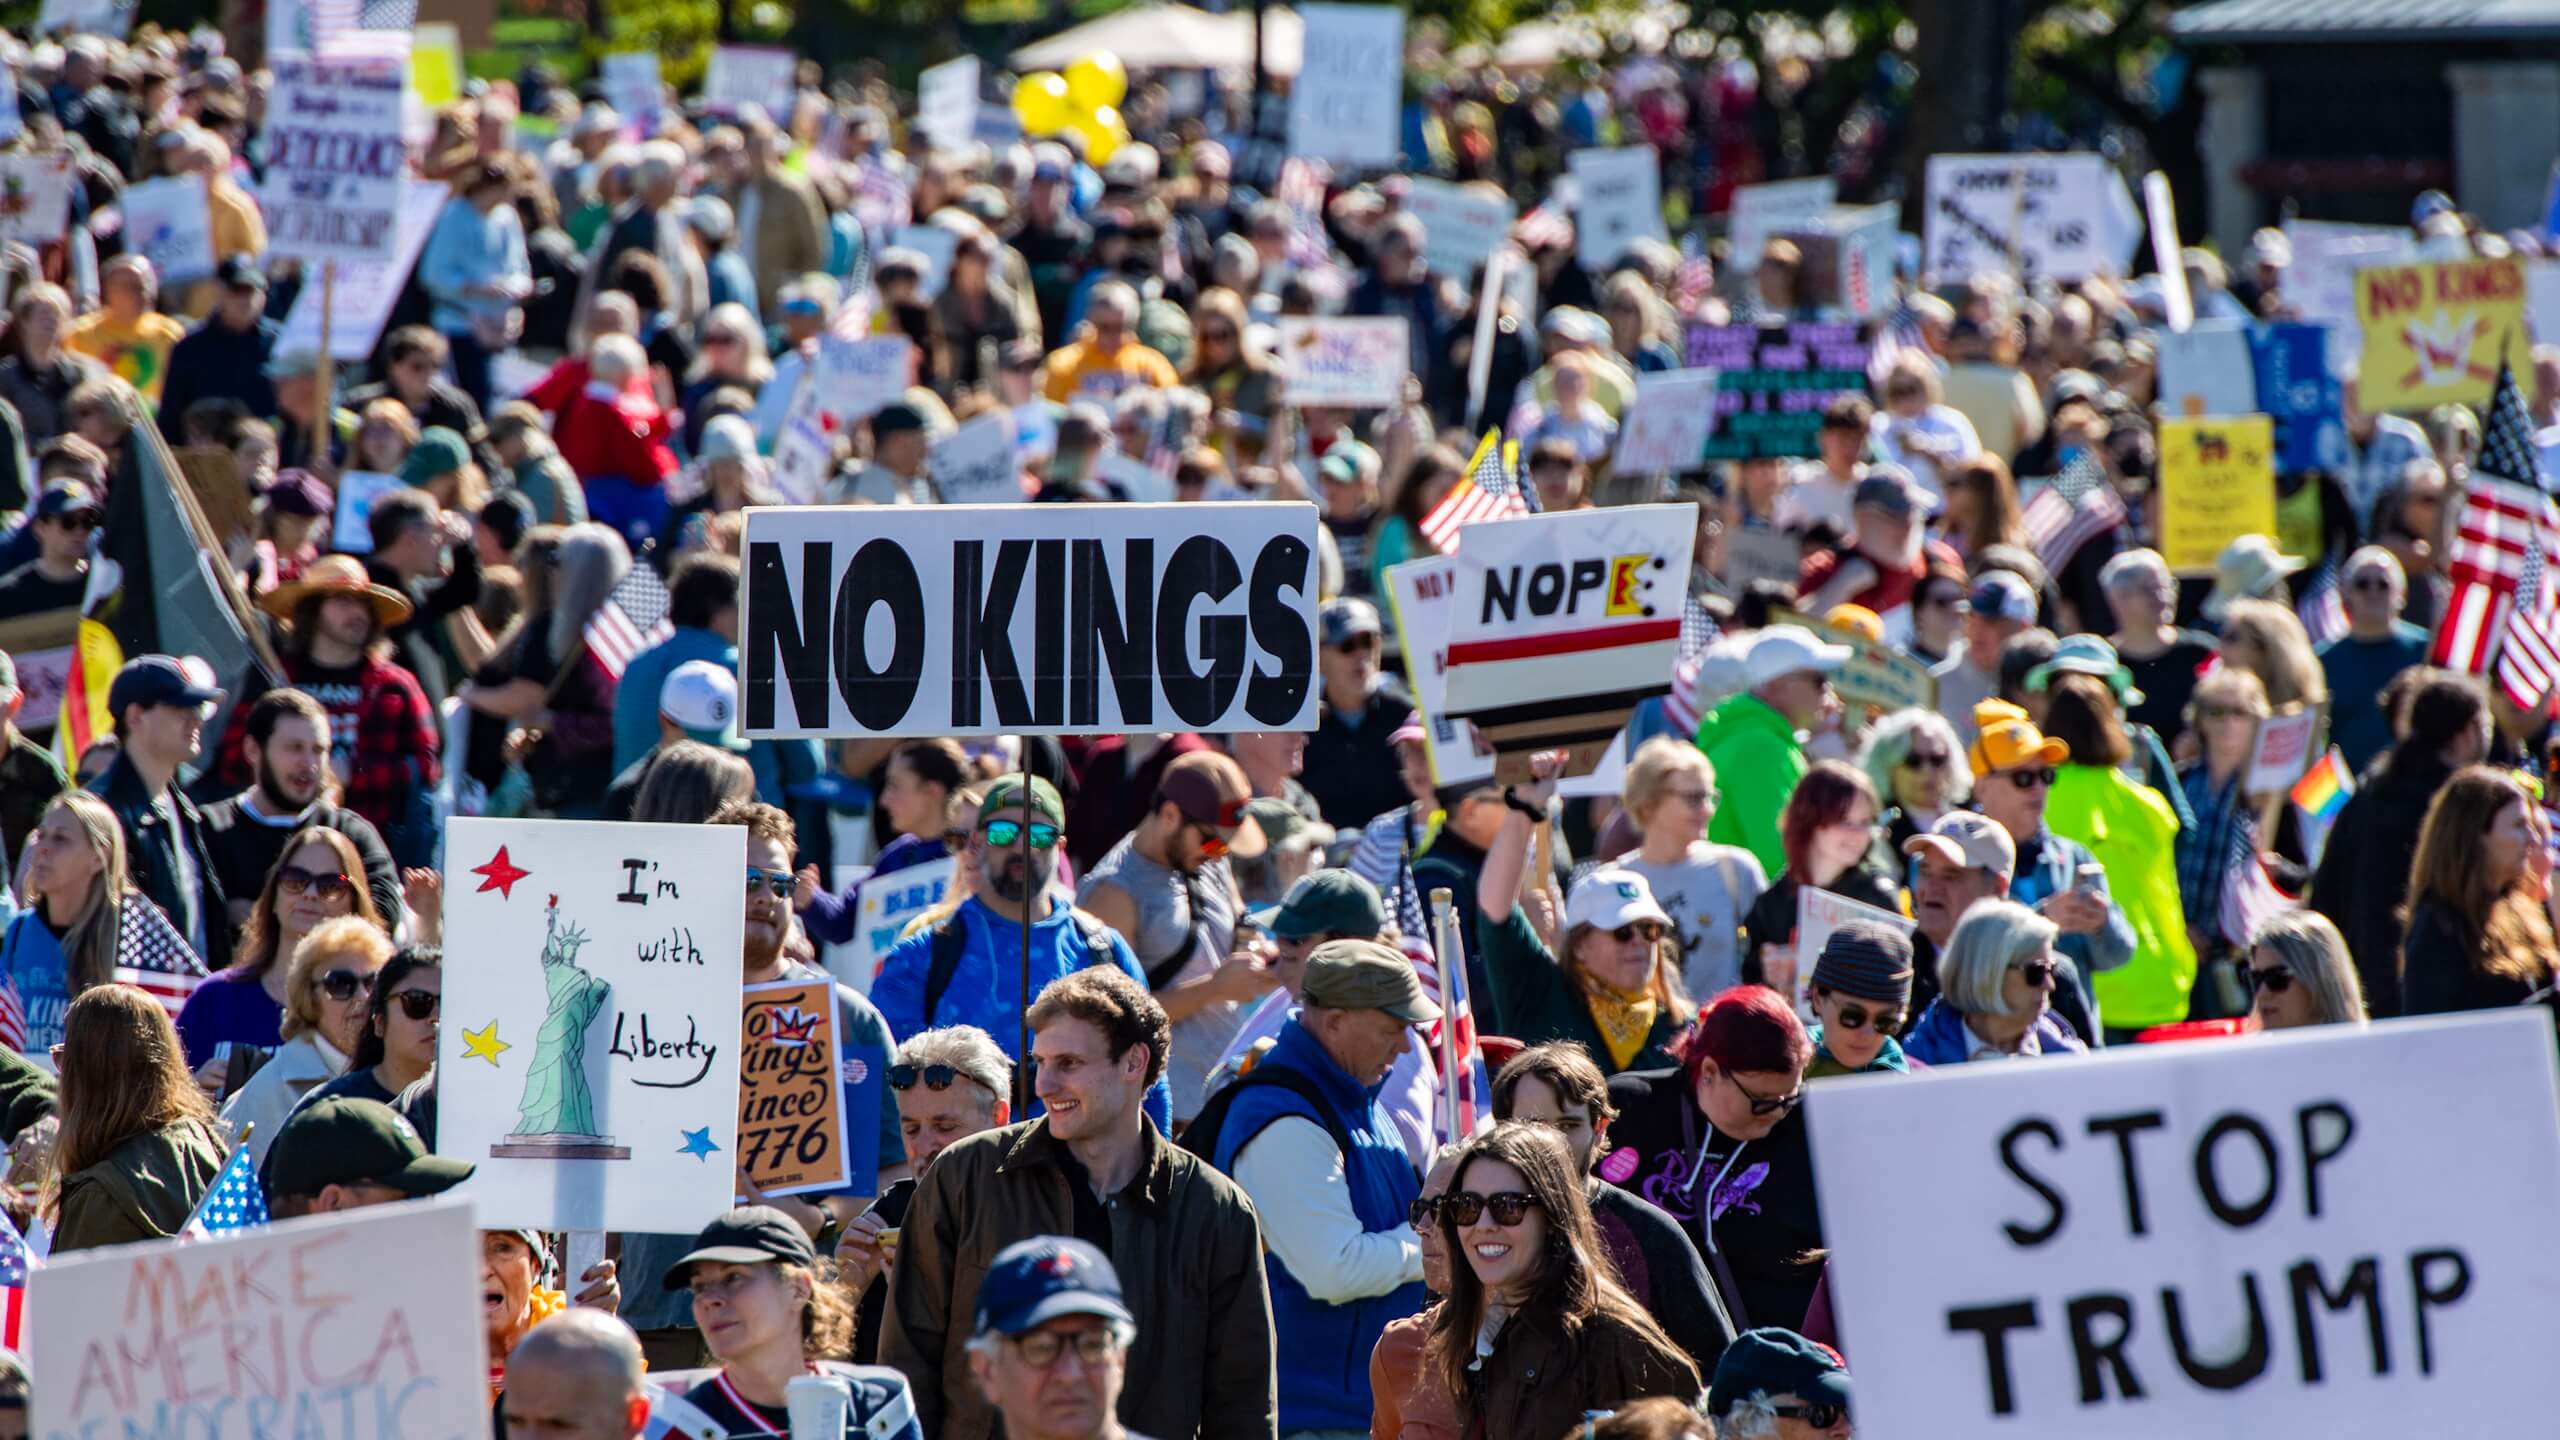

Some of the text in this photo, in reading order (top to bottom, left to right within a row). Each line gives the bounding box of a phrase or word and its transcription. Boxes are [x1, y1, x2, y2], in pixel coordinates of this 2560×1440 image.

[2369, 260, 2522, 319] NO KINGS
[1481, 554, 1660, 624] NOPE
[746, 534, 1312, 730] NO KINGS
[617, 859, 679, 905] I'm
[638, 927, 704, 966] with
[28, 996, 66, 1026] KIN
[608, 1011, 717, 1088] Liberty
[1997, 1100, 2356, 1247] STOP
[123, 1230, 355, 1329] MAKE
[70, 1306, 422, 1420] AMERICA
[1946, 1246, 2473, 1416] TRUMP
